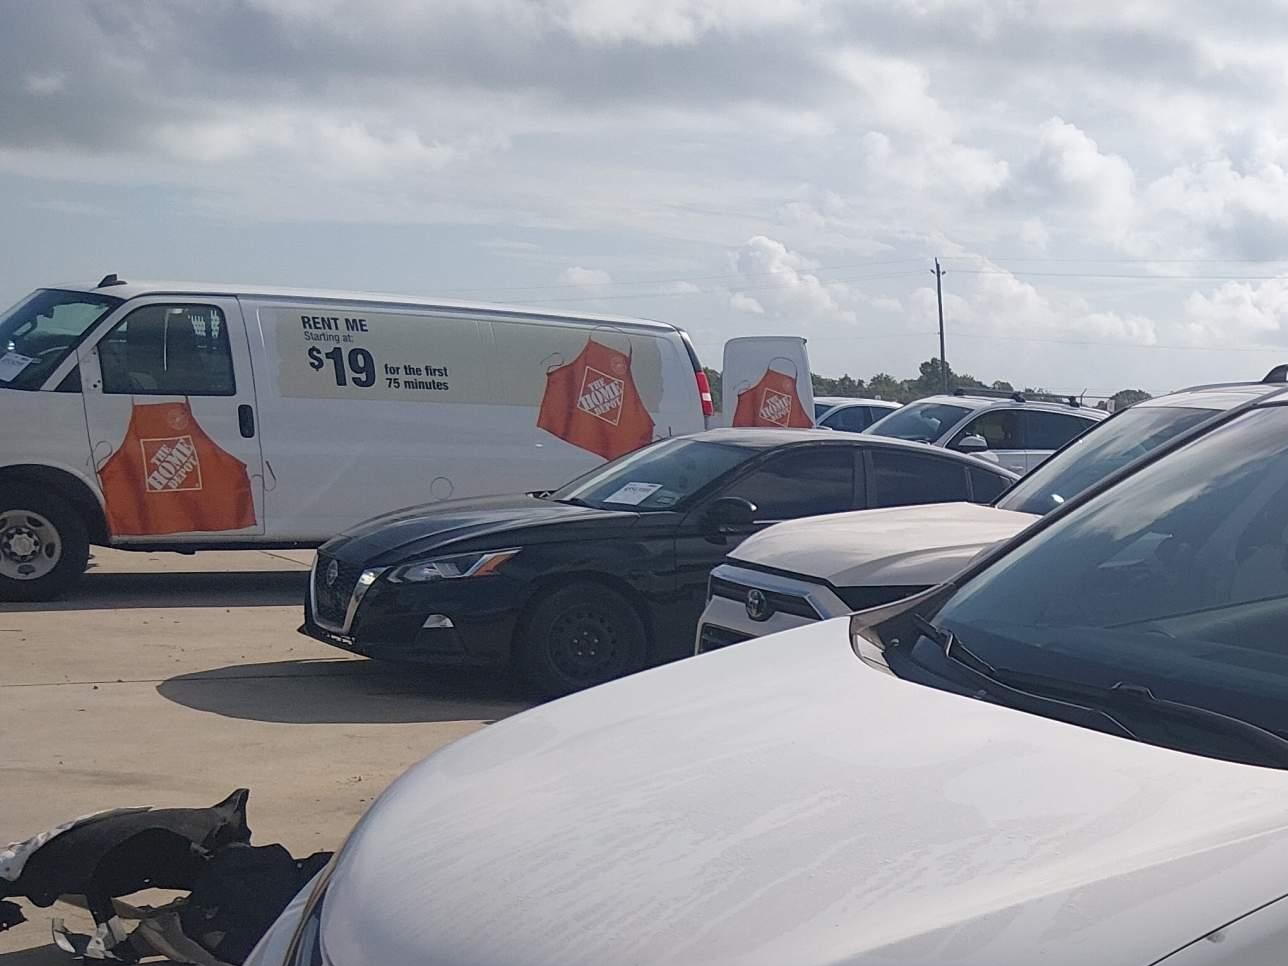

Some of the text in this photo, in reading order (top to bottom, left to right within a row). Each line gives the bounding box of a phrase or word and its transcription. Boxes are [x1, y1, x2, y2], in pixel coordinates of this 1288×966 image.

[301, 316, 368, 332] RENT ME
[304, 331, 353, 343] Starting at:
[308, 346, 376, 388] $19
[385, 364, 448, 377] for the first
[386, 378, 449, 391] 75 minutes
[588, 378, 606, 392] THE
[581, 381, 622, 411] HOME
[594, 398, 621, 415] DEPOT
[151, 443, 172, 466] THE
[149, 438, 193, 490] HOME
[168, 455, 197, 489] DEPOT
